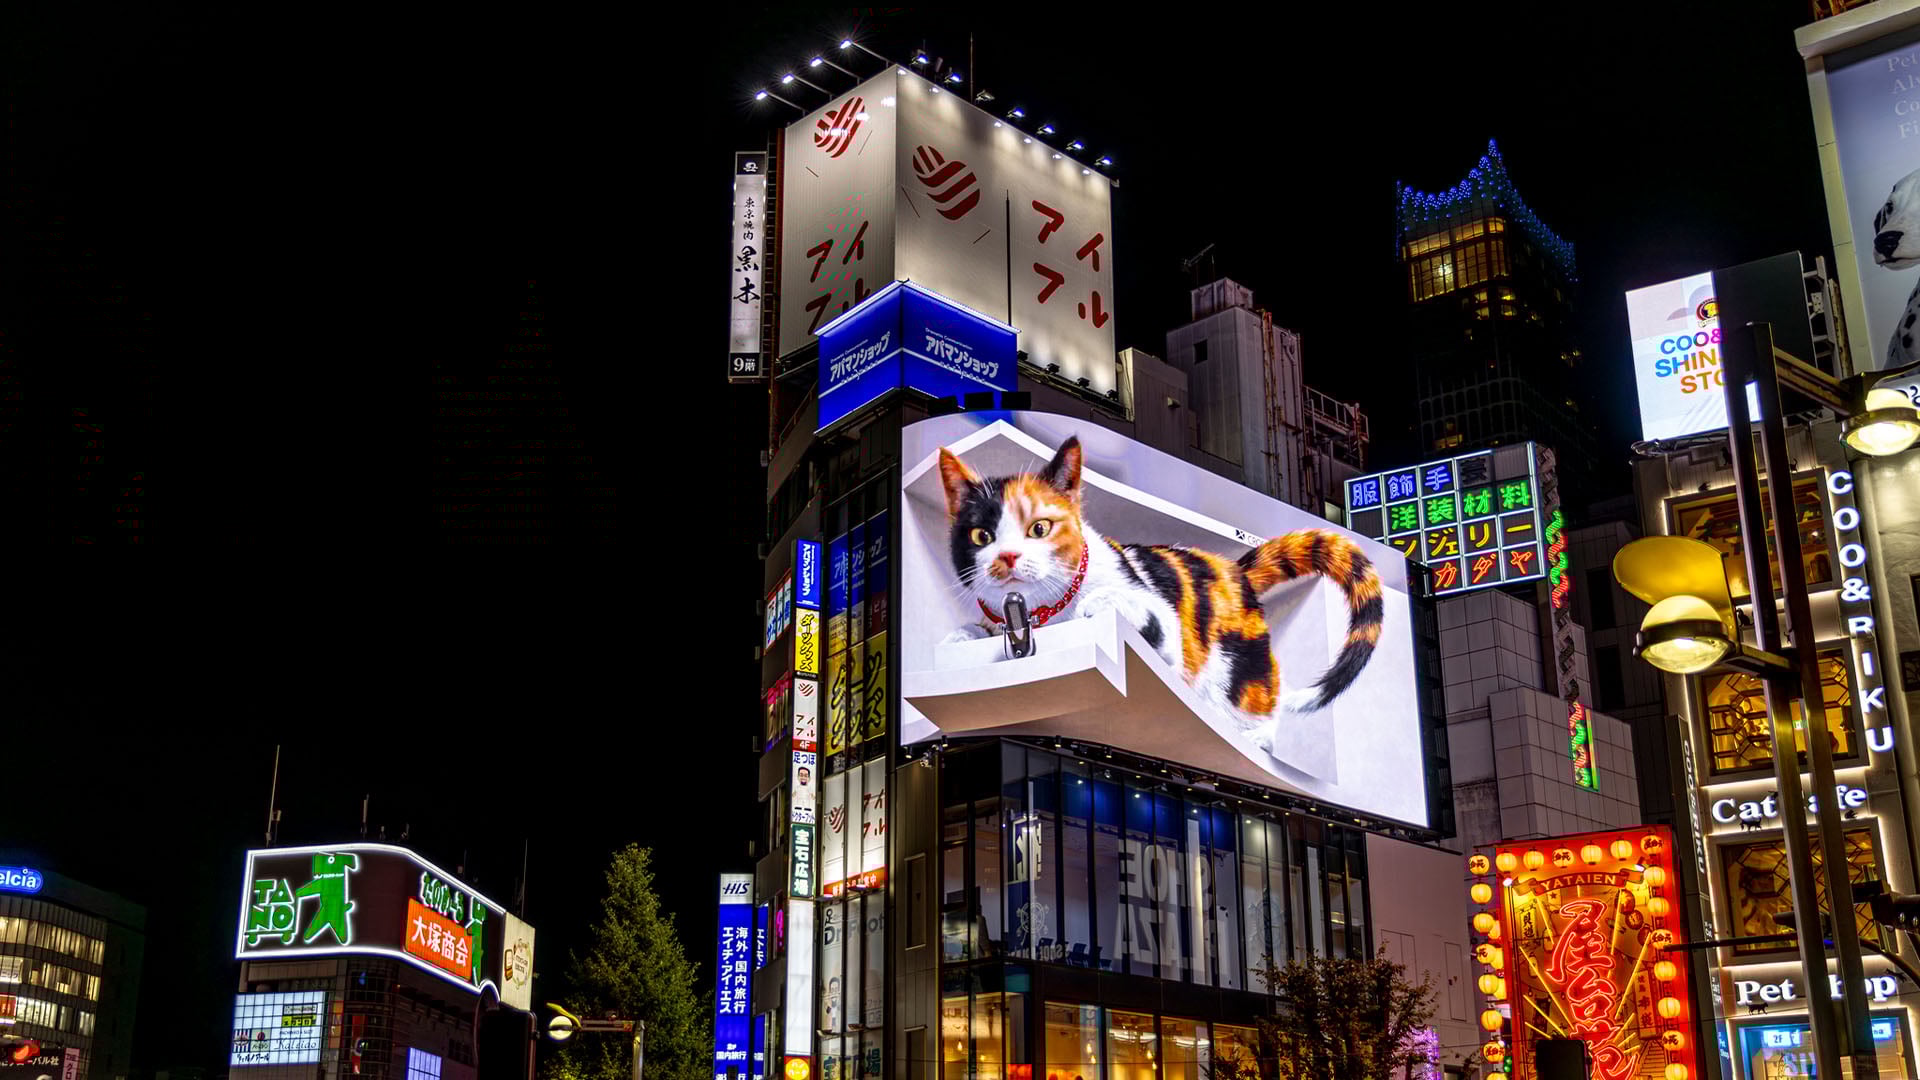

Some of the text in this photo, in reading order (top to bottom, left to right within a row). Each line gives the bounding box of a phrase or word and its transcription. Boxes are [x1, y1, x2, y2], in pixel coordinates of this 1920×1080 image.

[733, 245, 761, 304] 黒木
[830, 331, 890, 383] アパマンショップ
[925, 335, 999, 378] アパマンショップ
[1660, 328, 1721, 354] COO&
[1655, 348, 1722, 377] SHIN
[1391, 481, 1531, 530] 洋装材料
[802, 544, 811, 596] アパマンショップ
[1434, 551, 1533, 588] カダヤ
[801, 613, 815, 671] ダーツグッズ
[795, 727, 815, 738] フル
[796, 714, 815, 726] アイ
[793, 751, 816, 766] 足つぼ
[799, 741, 810, 750] 4F
[1711, 796, 1778, 823] Cat
[794, 829, 810, 896] 宝石広場
[1541, 873, 1617, 890] YATAIEN
[421, 872, 464, 923] たのめーる
[722, 883, 750, 895] HIS
[411, 915, 469, 967] 大塚商会
[720, 927, 733, 1013] エイチ・アイ・エス
[734, 927, 748, 1014] 海外・国内旅行
[1735, 978, 1797, 1005] Pet
